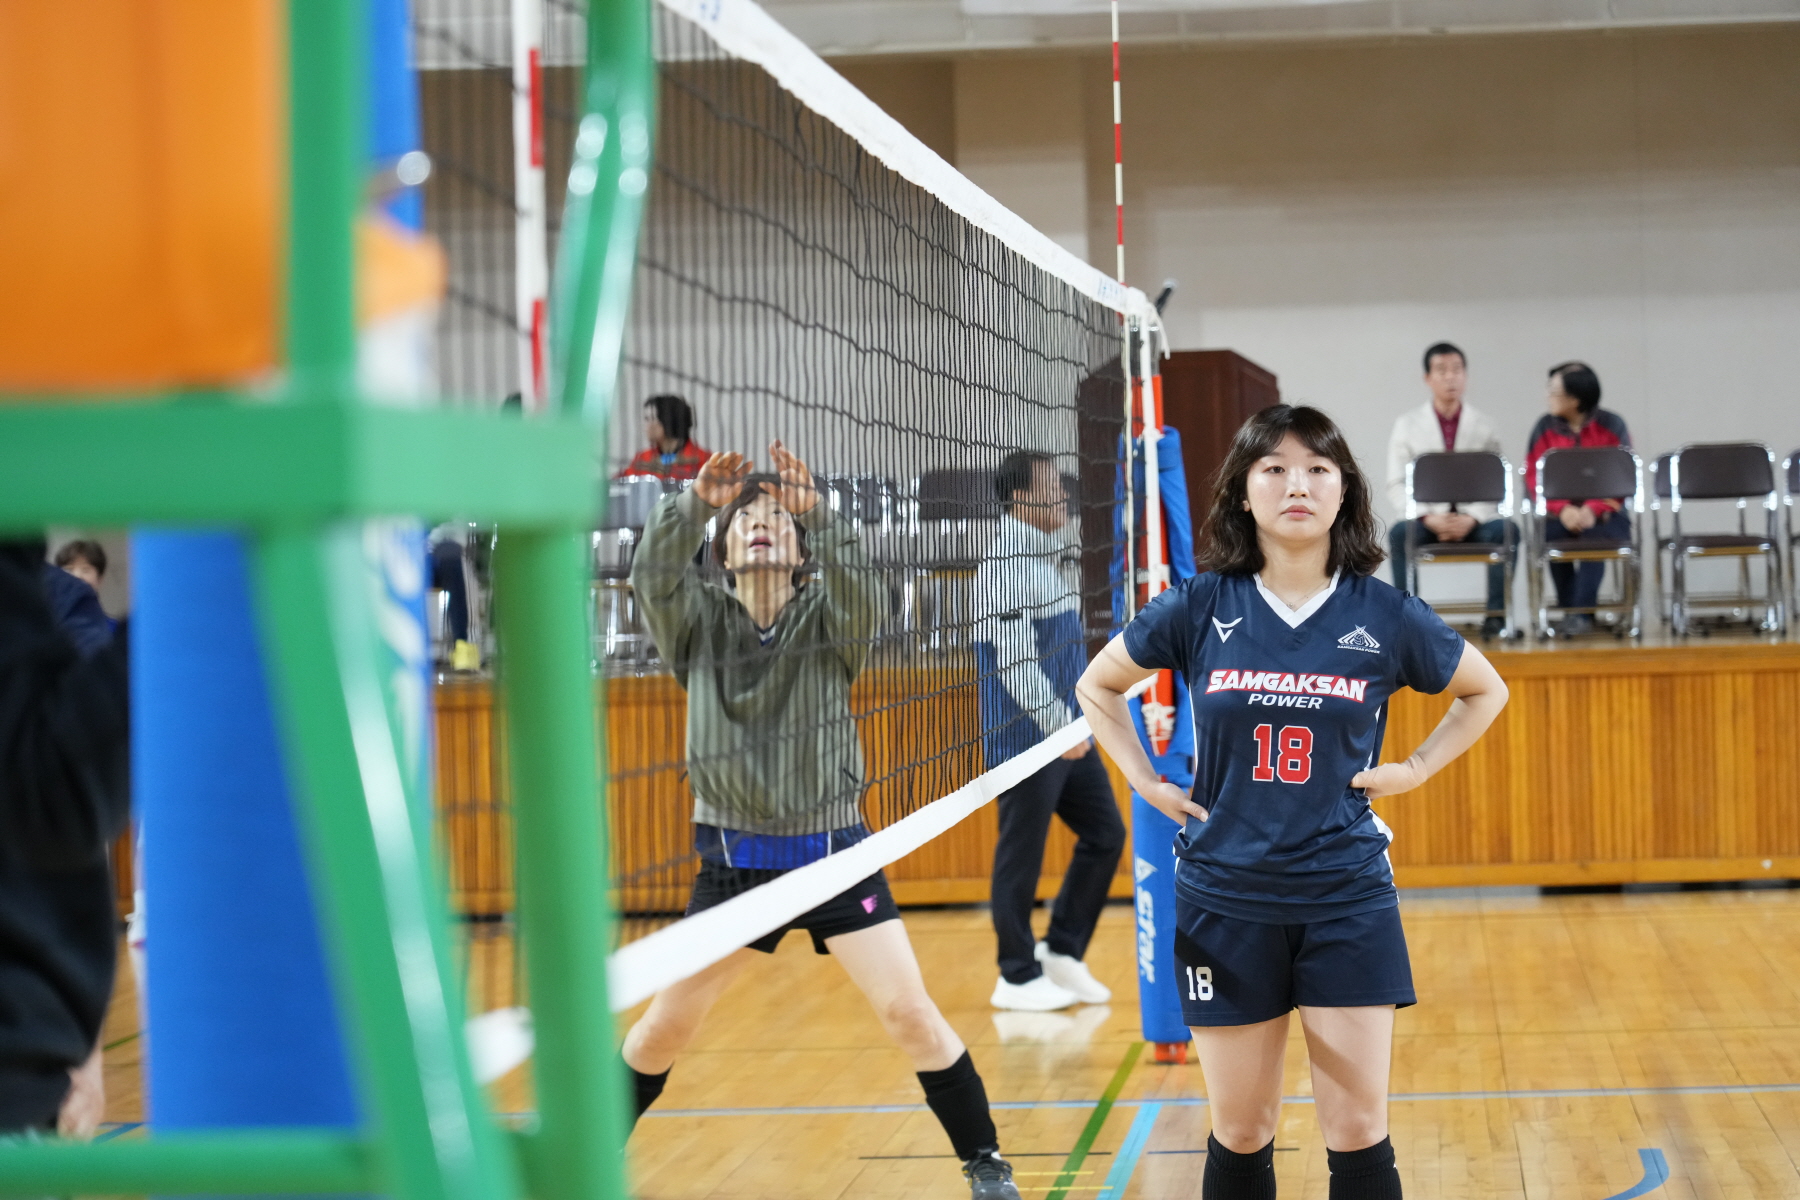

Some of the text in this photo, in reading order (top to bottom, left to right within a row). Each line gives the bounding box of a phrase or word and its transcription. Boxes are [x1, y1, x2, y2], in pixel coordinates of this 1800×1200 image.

[1205, 669, 1368, 703] SAMGAKSAN
[1248, 693, 1323, 709] POWER
[1253, 724, 1313, 784] 18
[1186, 966, 1213, 1001] 18
